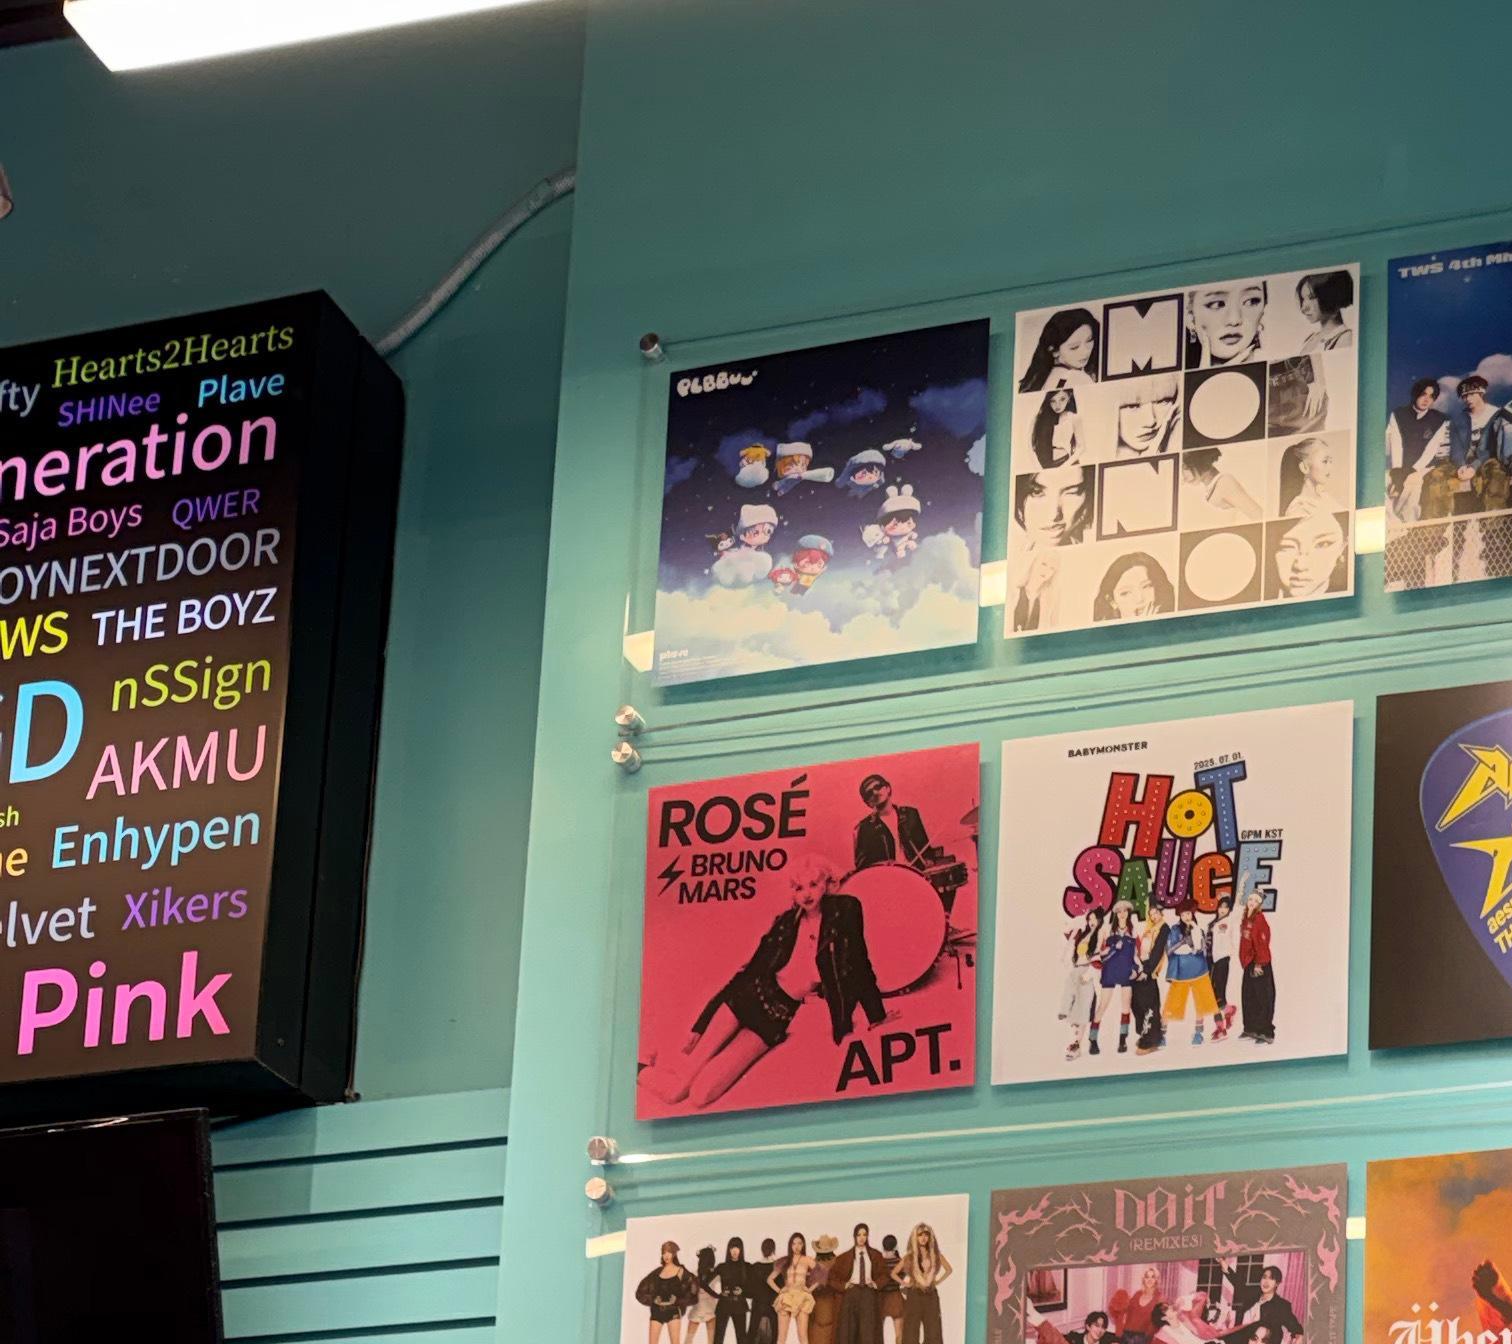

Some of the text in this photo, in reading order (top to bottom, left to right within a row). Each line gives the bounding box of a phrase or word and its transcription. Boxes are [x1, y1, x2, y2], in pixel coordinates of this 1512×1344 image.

[1397, 262, 1443, 279] TWS
[1448, 255, 1483, 271] 4th
[51, 324, 294, 388] Hearts2Hearts
[57, 392, 162, 428] SHINee
[197, 373, 285, 408] Plave
[0, 412, 278, 501] neration
[0, 503, 144, 552] Saja Boys
[172, 488, 262, 530] QWER
[0, 527, 281, 604] OYNEXTDOOR
[0, 610, 69, 661] WS
[92, 587, 278, 647] THE BOYZ
[111, 656, 272, 711] nSSign
[86, 724, 267, 800] AKMU
[1067, 741, 1149, 758] BABYMONSTER
[658, 774, 811, 848] ROSÉ
[1098, 760, 1248, 859] HOT
[1241, 828, 1284, 840] 6PM KST
[52, 811, 261, 870] Enhypen
[690, 848, 788, 877] BRUNO
[678, 877, 757, 904] MARS
[1062, 837, 1284, 922] SAUCE
[0, 897, 97, 948] lvet
[121, 886, 249, 931] Xikers
[17, 950, 233, 1055] Pink
[835, 1023, 961, 1093] APT.
[1129, 1234, 1203, 1253] (REMIXES)
